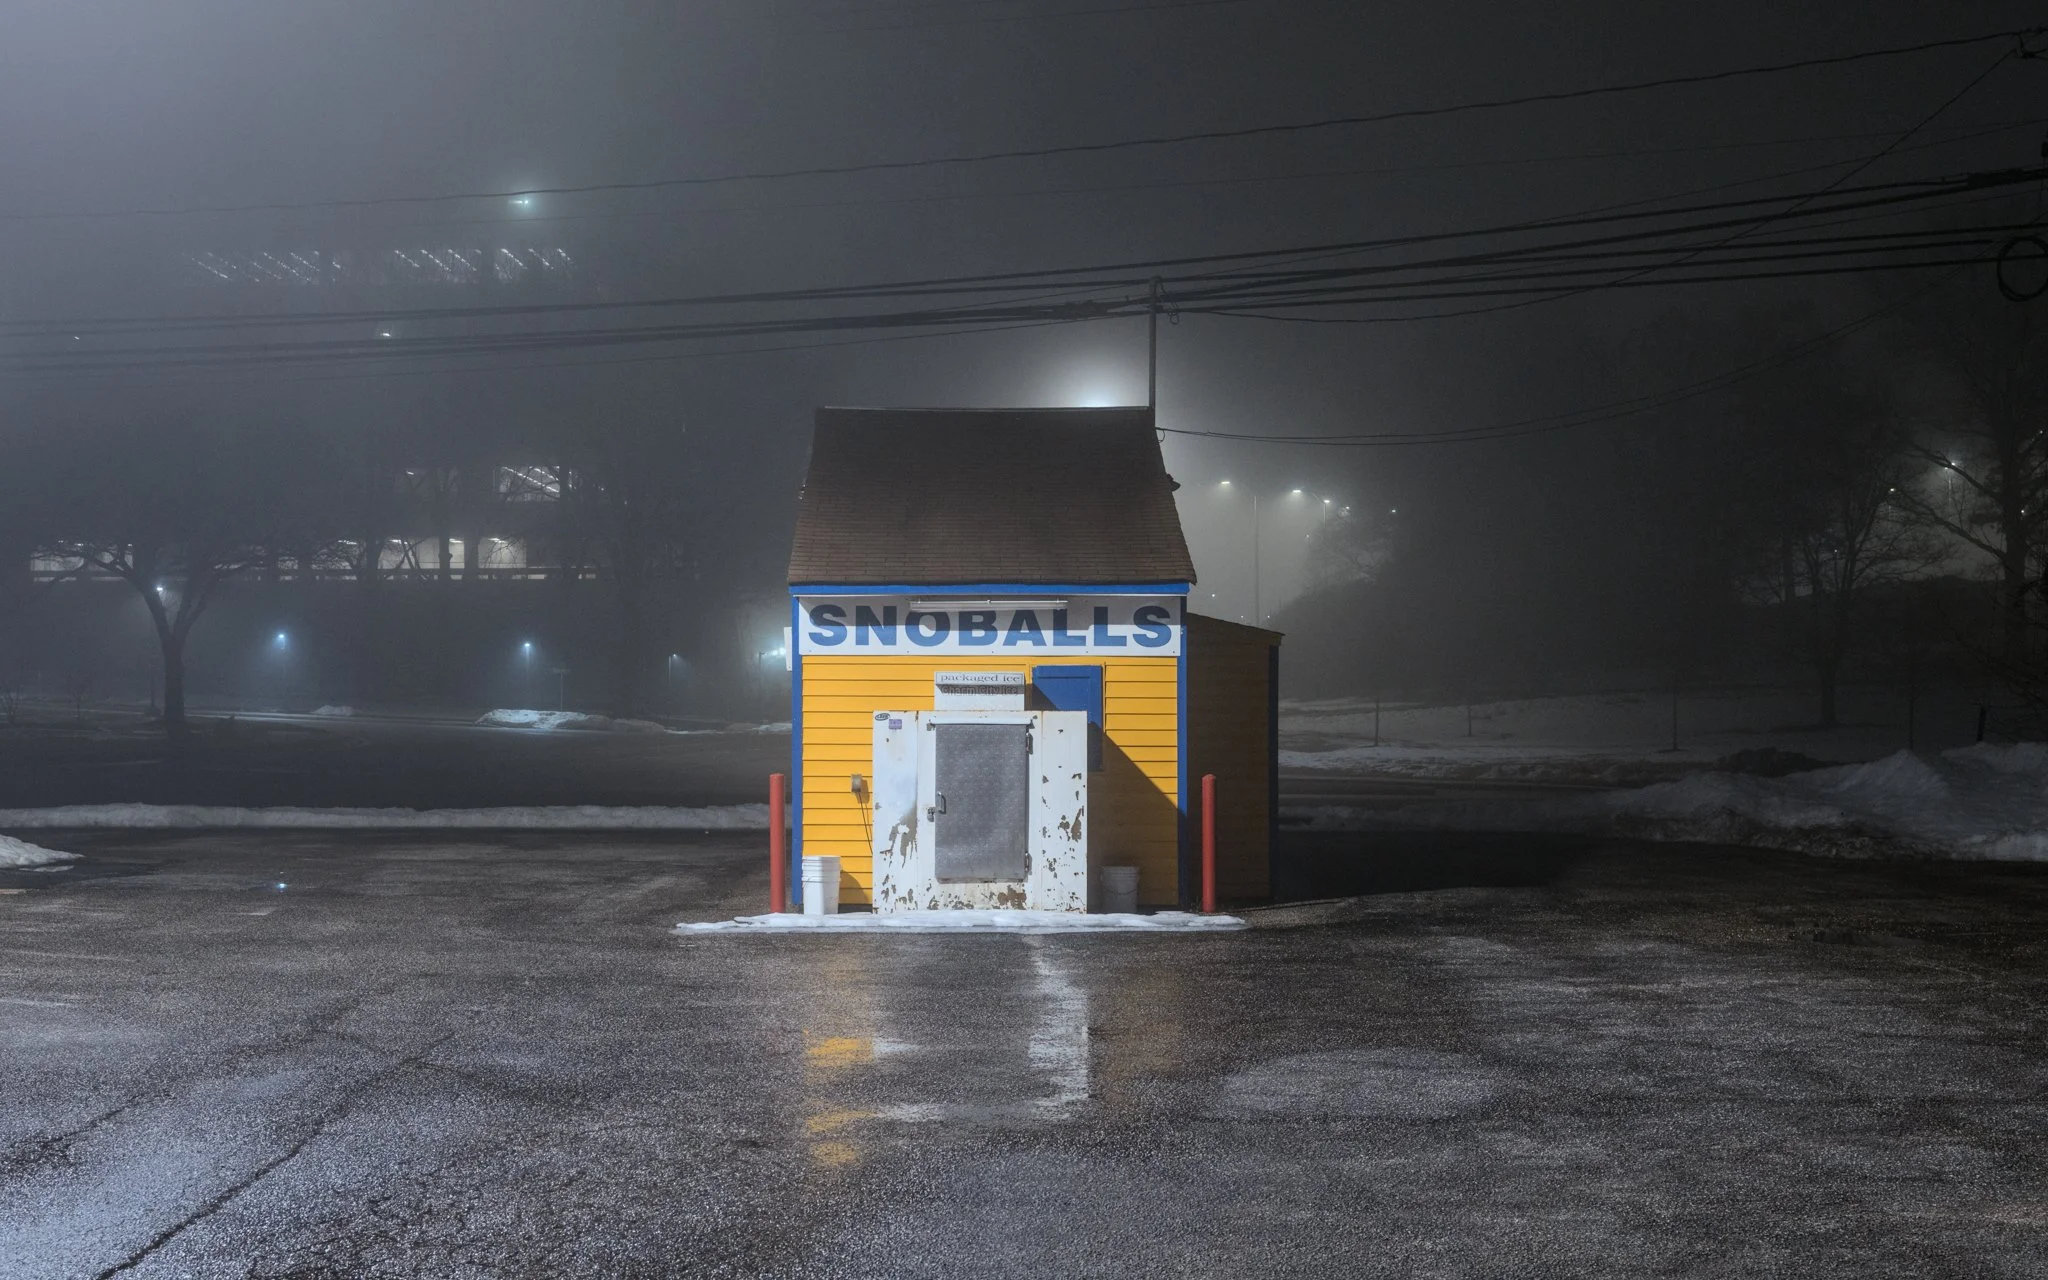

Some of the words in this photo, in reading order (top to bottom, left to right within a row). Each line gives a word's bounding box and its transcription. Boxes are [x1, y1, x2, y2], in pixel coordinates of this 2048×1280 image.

[808, 604, 1172, 648] SNOBALLS
[940, 673, 998, 683] packaged
[1003, 674, 1020, 682] ice
[941, 685, 976, 695] Charm
